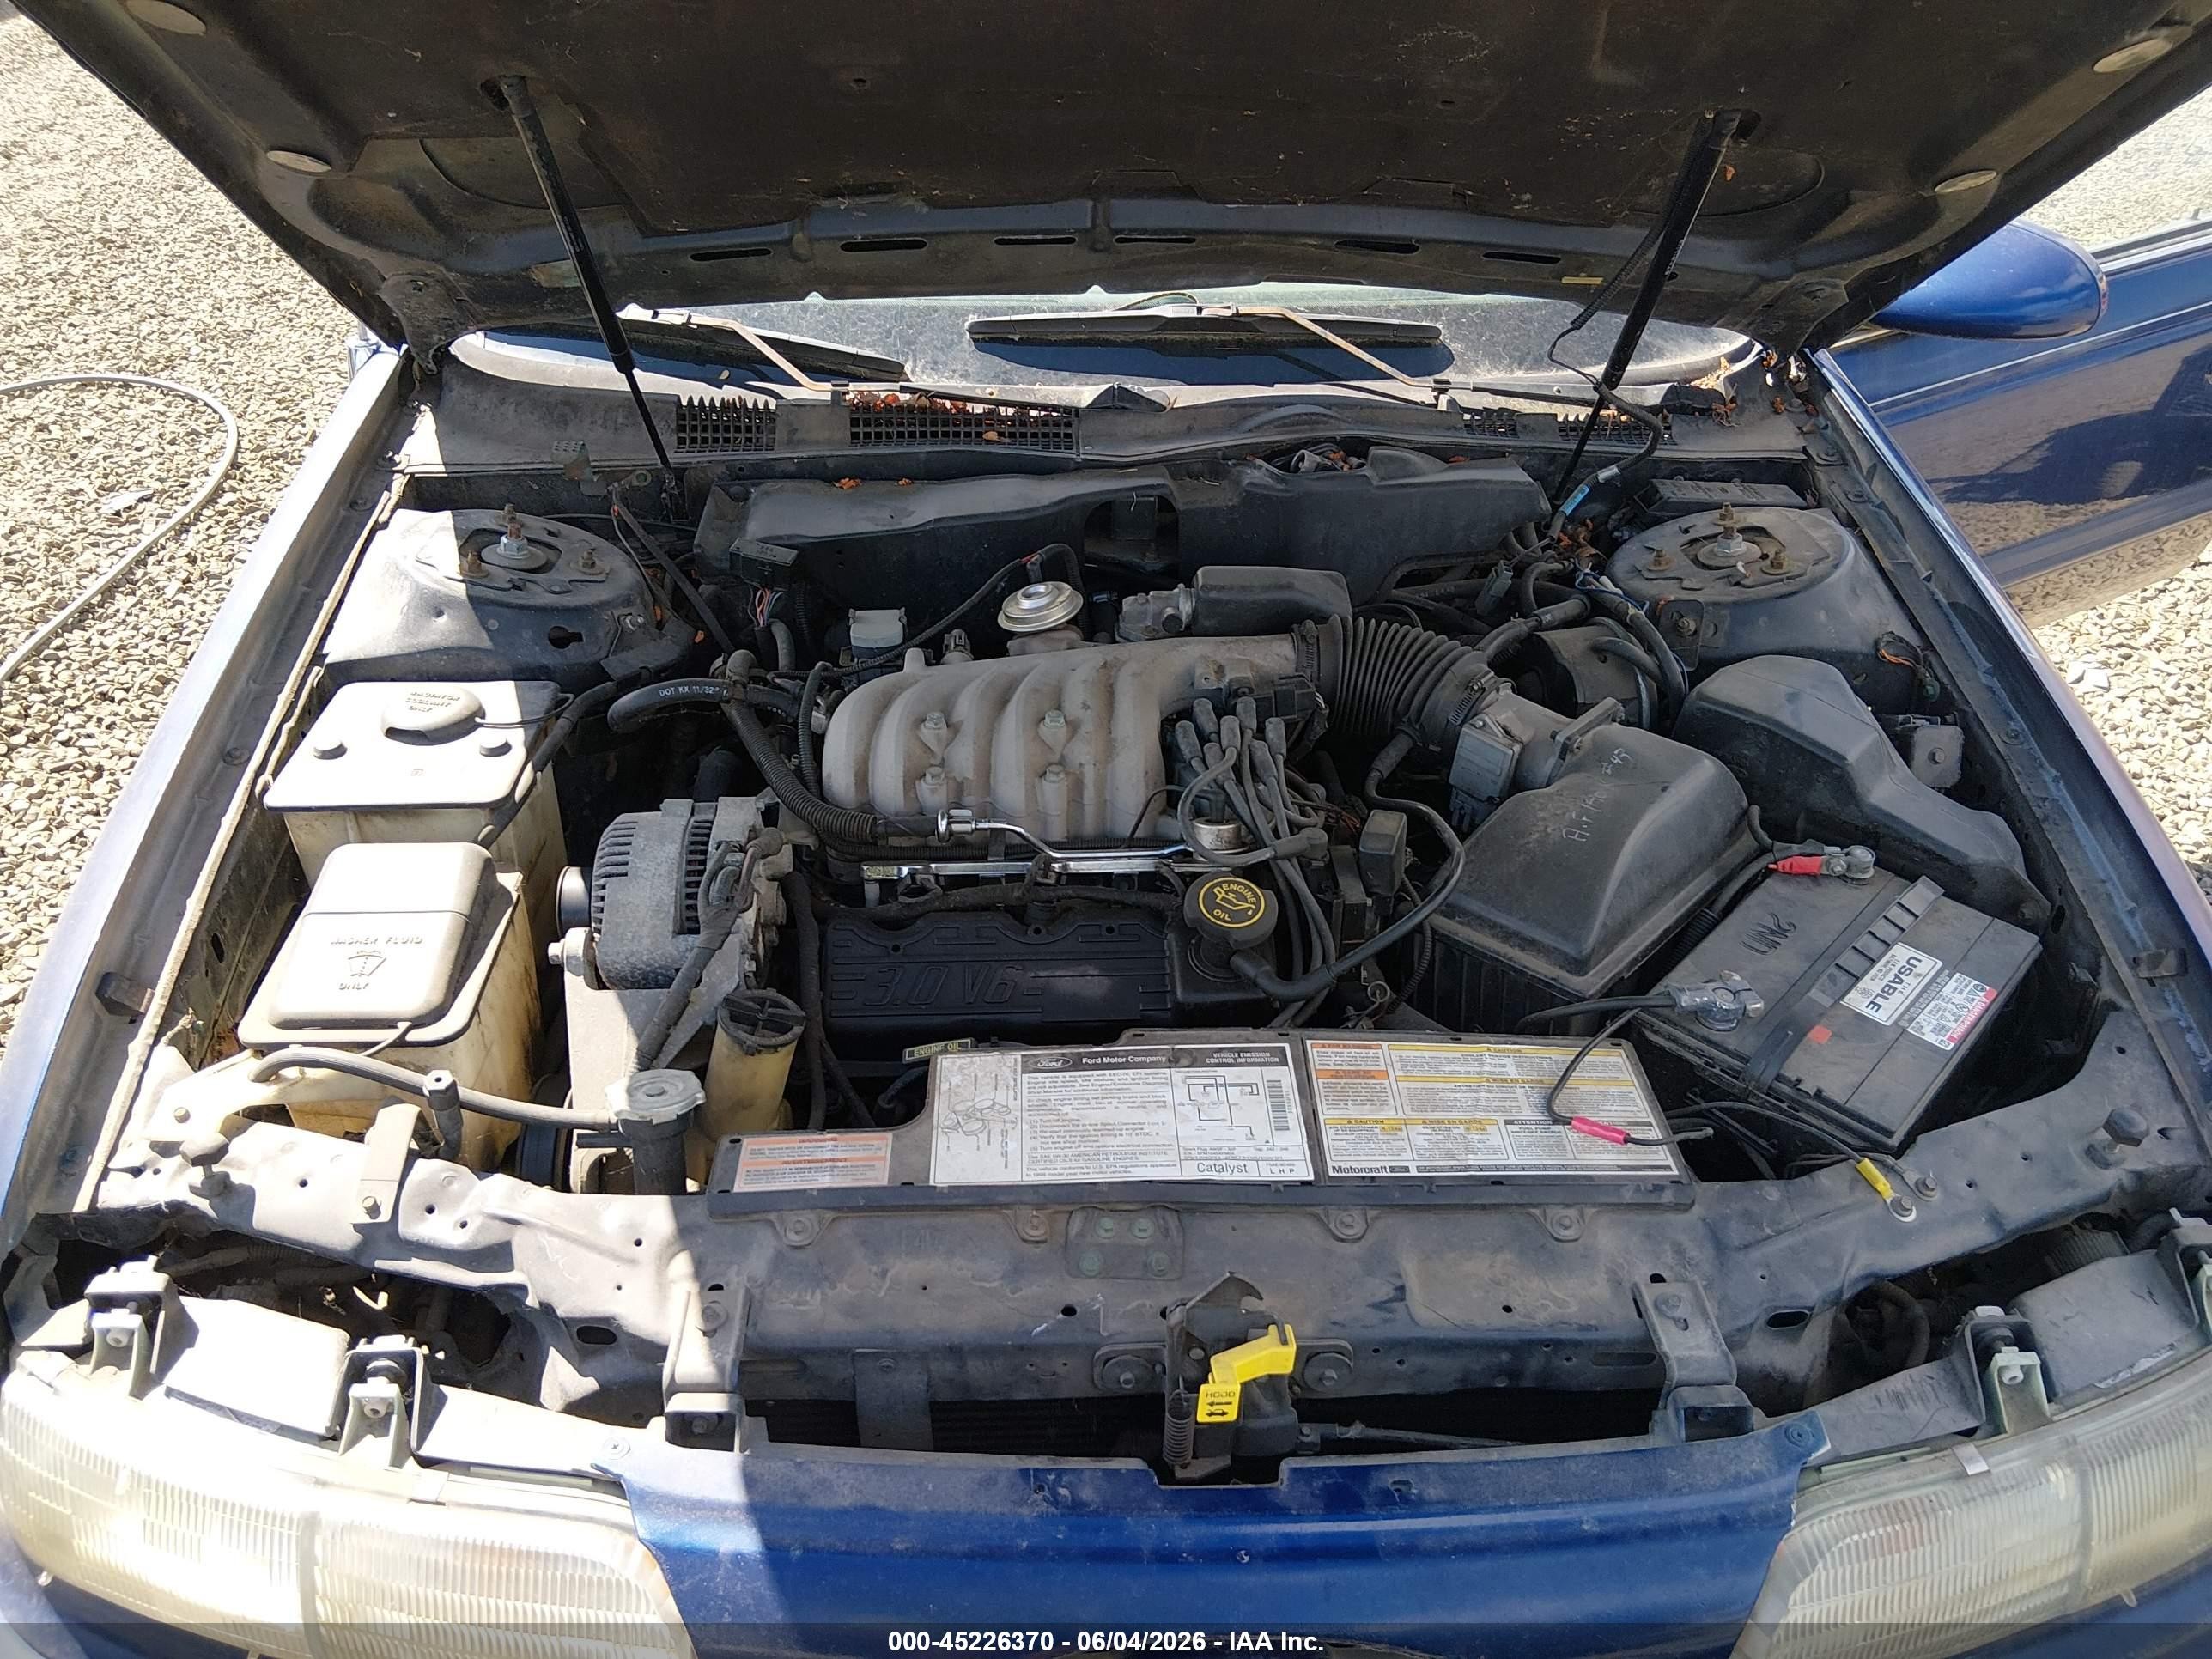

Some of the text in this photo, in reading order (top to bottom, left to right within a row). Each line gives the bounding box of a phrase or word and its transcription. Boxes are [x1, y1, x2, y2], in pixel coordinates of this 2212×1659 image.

[659, 688, 675, 696] DOT
[1222, 883, 1256, 904] ENGINE
[1213, 908, 1231, 921] OIL
[864, 965, 1024, 1007] 3.0 V6
[1864, 955, 1923, 1013] USABLE
[947, 1042, 962, 1052] OIL
[1127, 1055, 1166, 1064] Company
[1197, 1162, 1248, 1175] Catalyst
[1332, 1165, 1389, 1174] Motorcraft
[1206, 1390, 1236, 1399] HOOD
